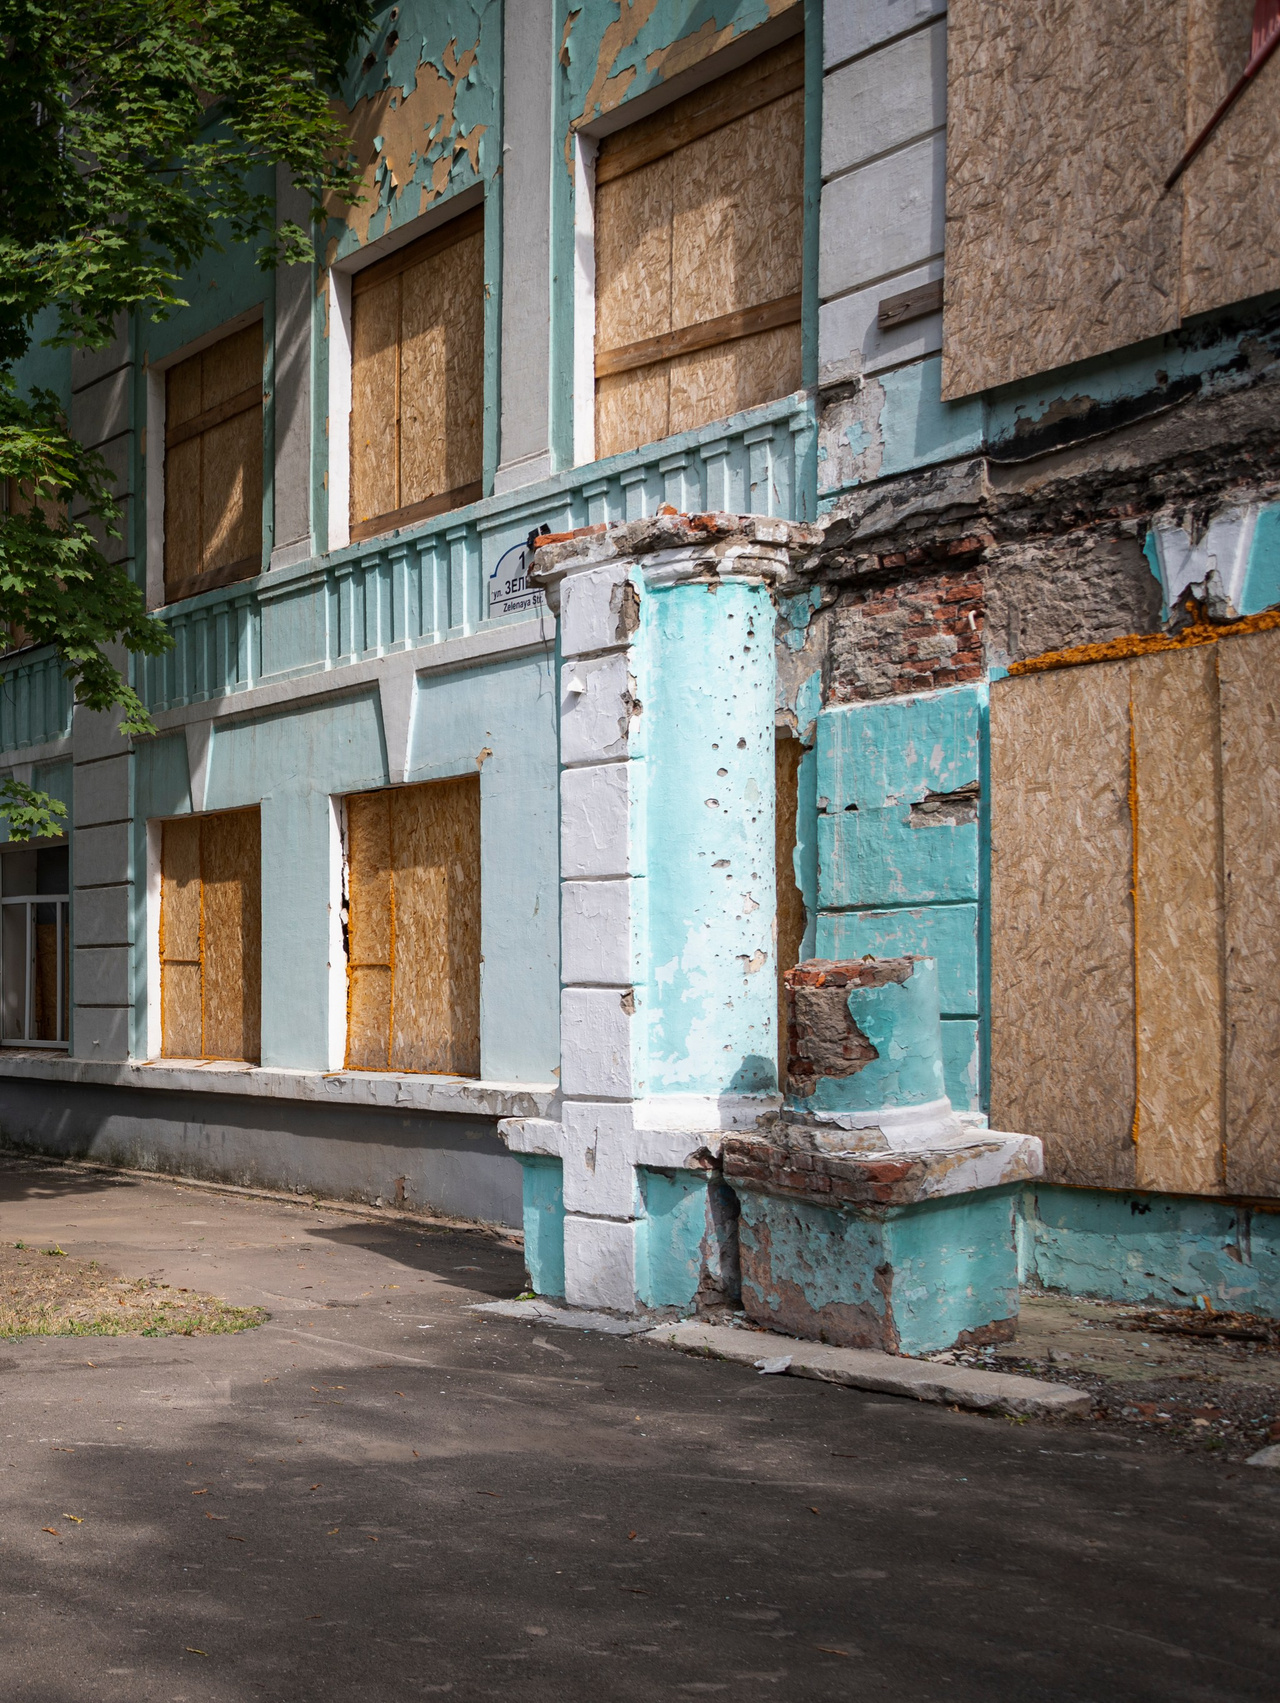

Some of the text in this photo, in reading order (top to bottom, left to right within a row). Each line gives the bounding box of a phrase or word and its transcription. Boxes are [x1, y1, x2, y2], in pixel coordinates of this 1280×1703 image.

[519, 551, 525, 570] 1
[503, 594, 544, 612] Zelenaya Str.
